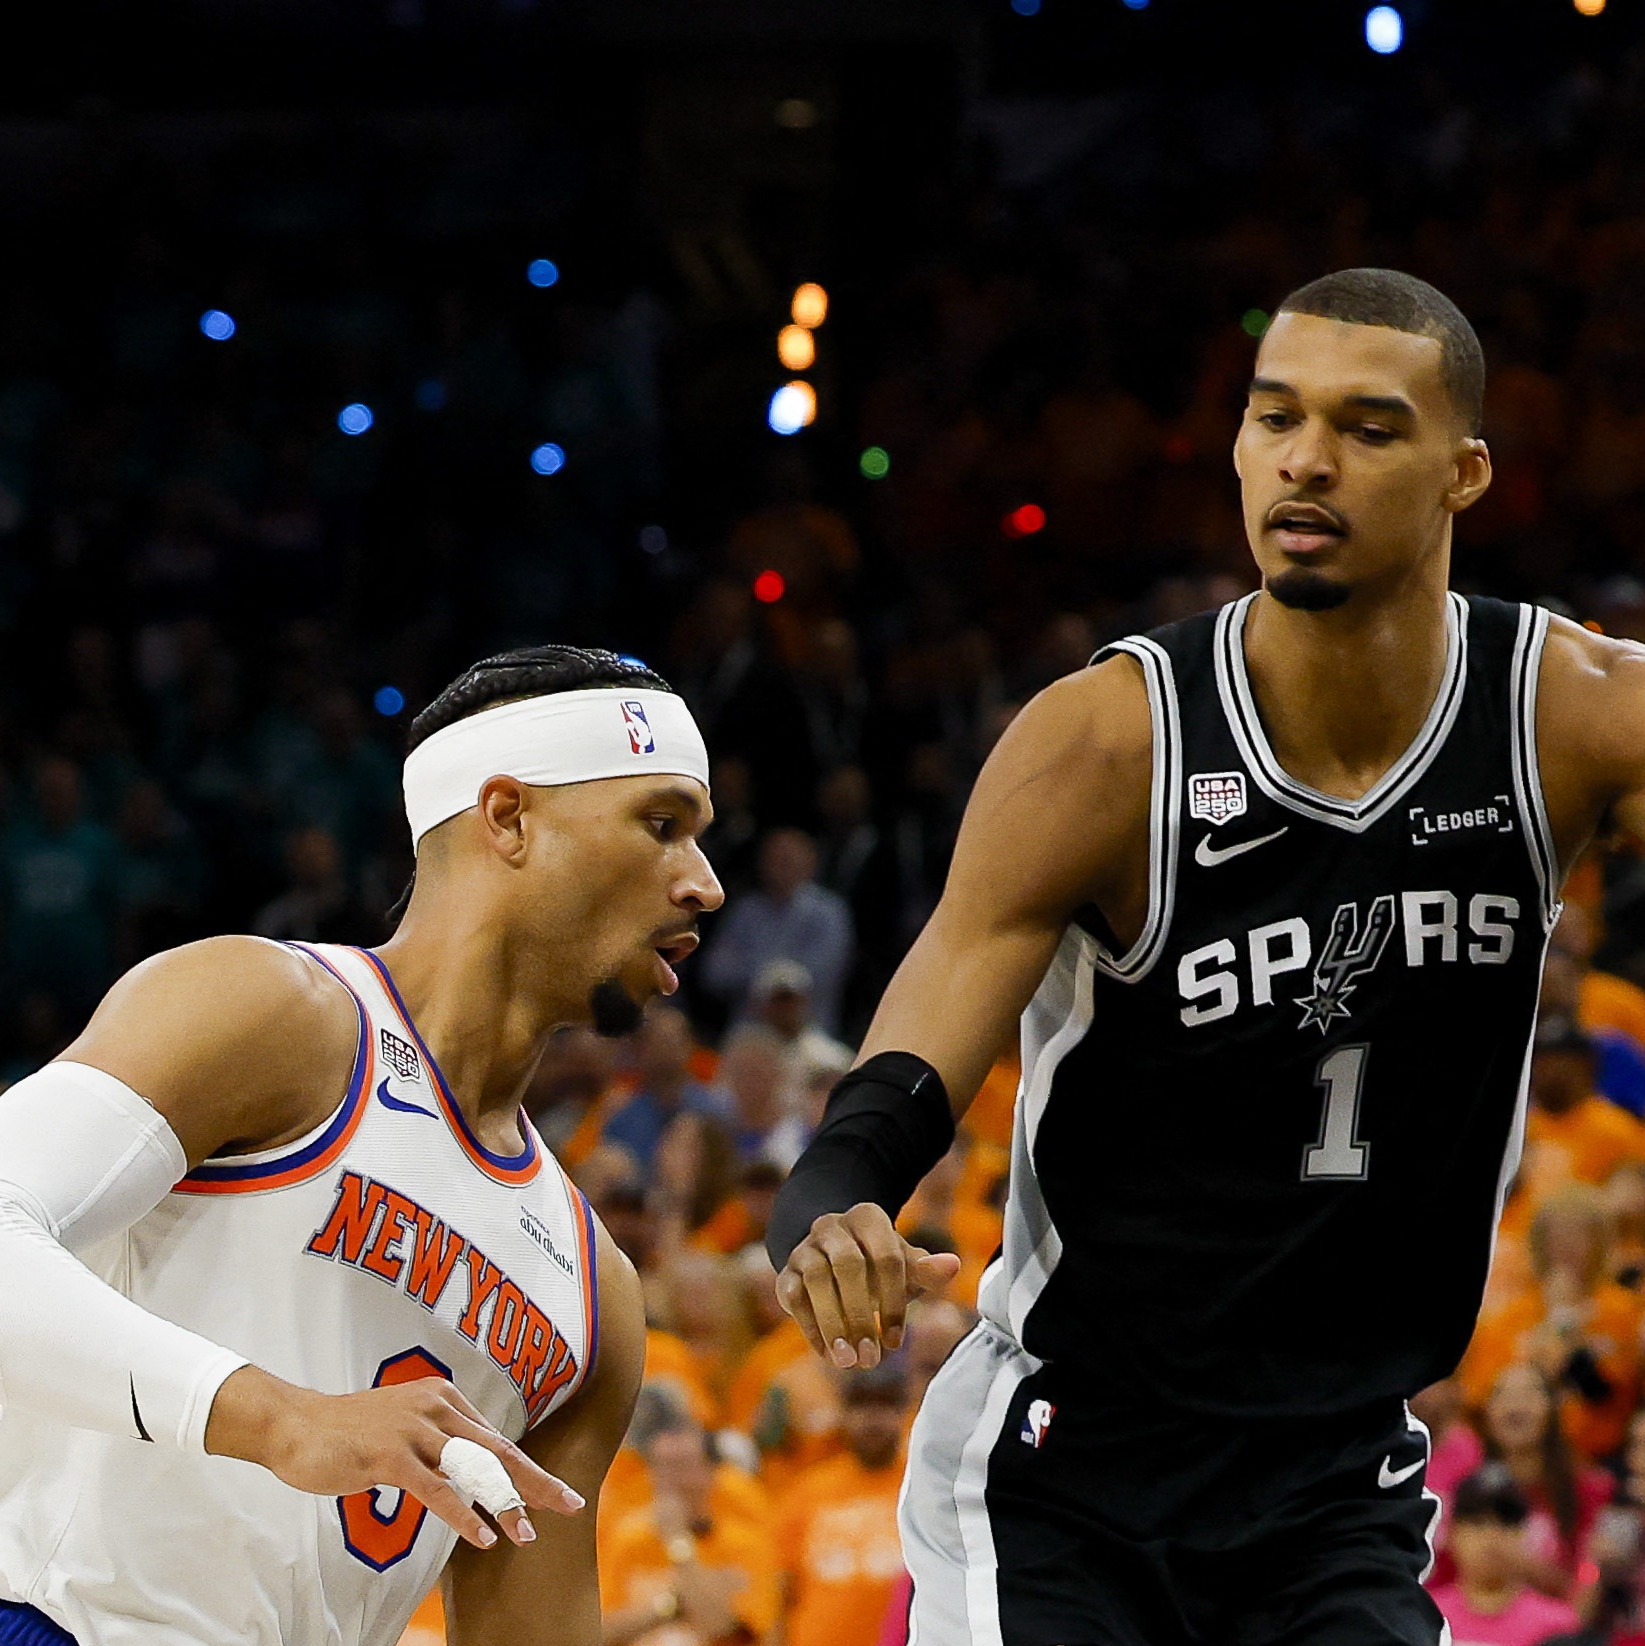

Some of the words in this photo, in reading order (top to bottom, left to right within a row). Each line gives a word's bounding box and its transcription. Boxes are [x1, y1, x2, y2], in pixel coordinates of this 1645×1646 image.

[1196, 779, 1240, 793] USA
[1195, 798, 1243, 813] 250
[1423, 807, 1499, 833] LEDGER
[383, 1031, 416, 1059] USA
[1300, 1042, 1371, 1182] 1
[519, 1217, 542, 1244] abu
[542, 1237, 574, 1276] dhabi
[303, 1166, 468, 1315] NEW
[455, 1242, 578, 1430] YORK
